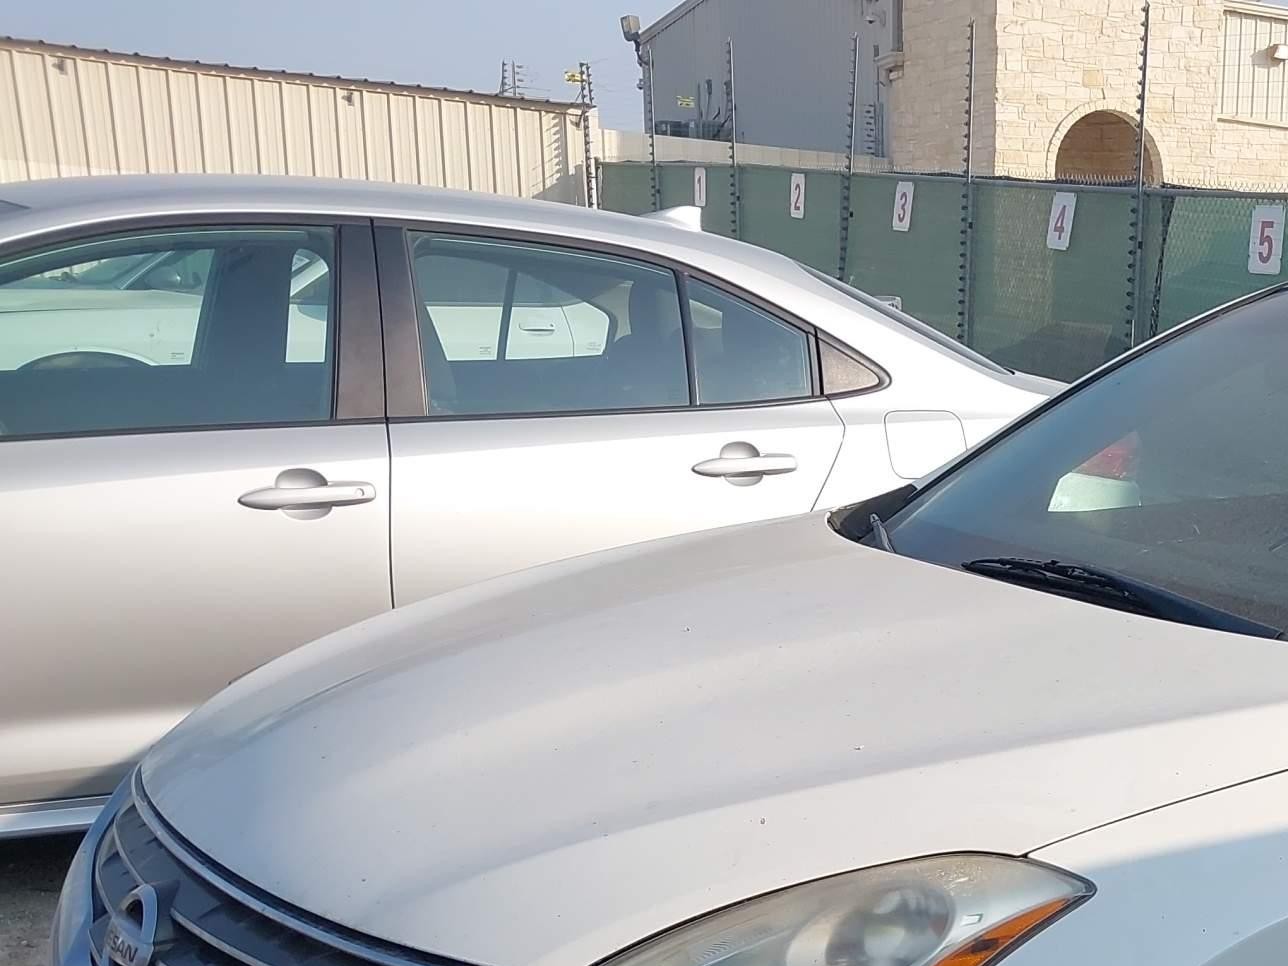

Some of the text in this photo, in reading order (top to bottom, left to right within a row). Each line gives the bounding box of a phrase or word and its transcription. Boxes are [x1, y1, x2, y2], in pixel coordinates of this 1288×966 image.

[793, 183, 802, 211] 2
[898, 191, 908, 223] 3
[1053, 204, 1067, 241] 4
[1258, 220, 1275, 264] 5
